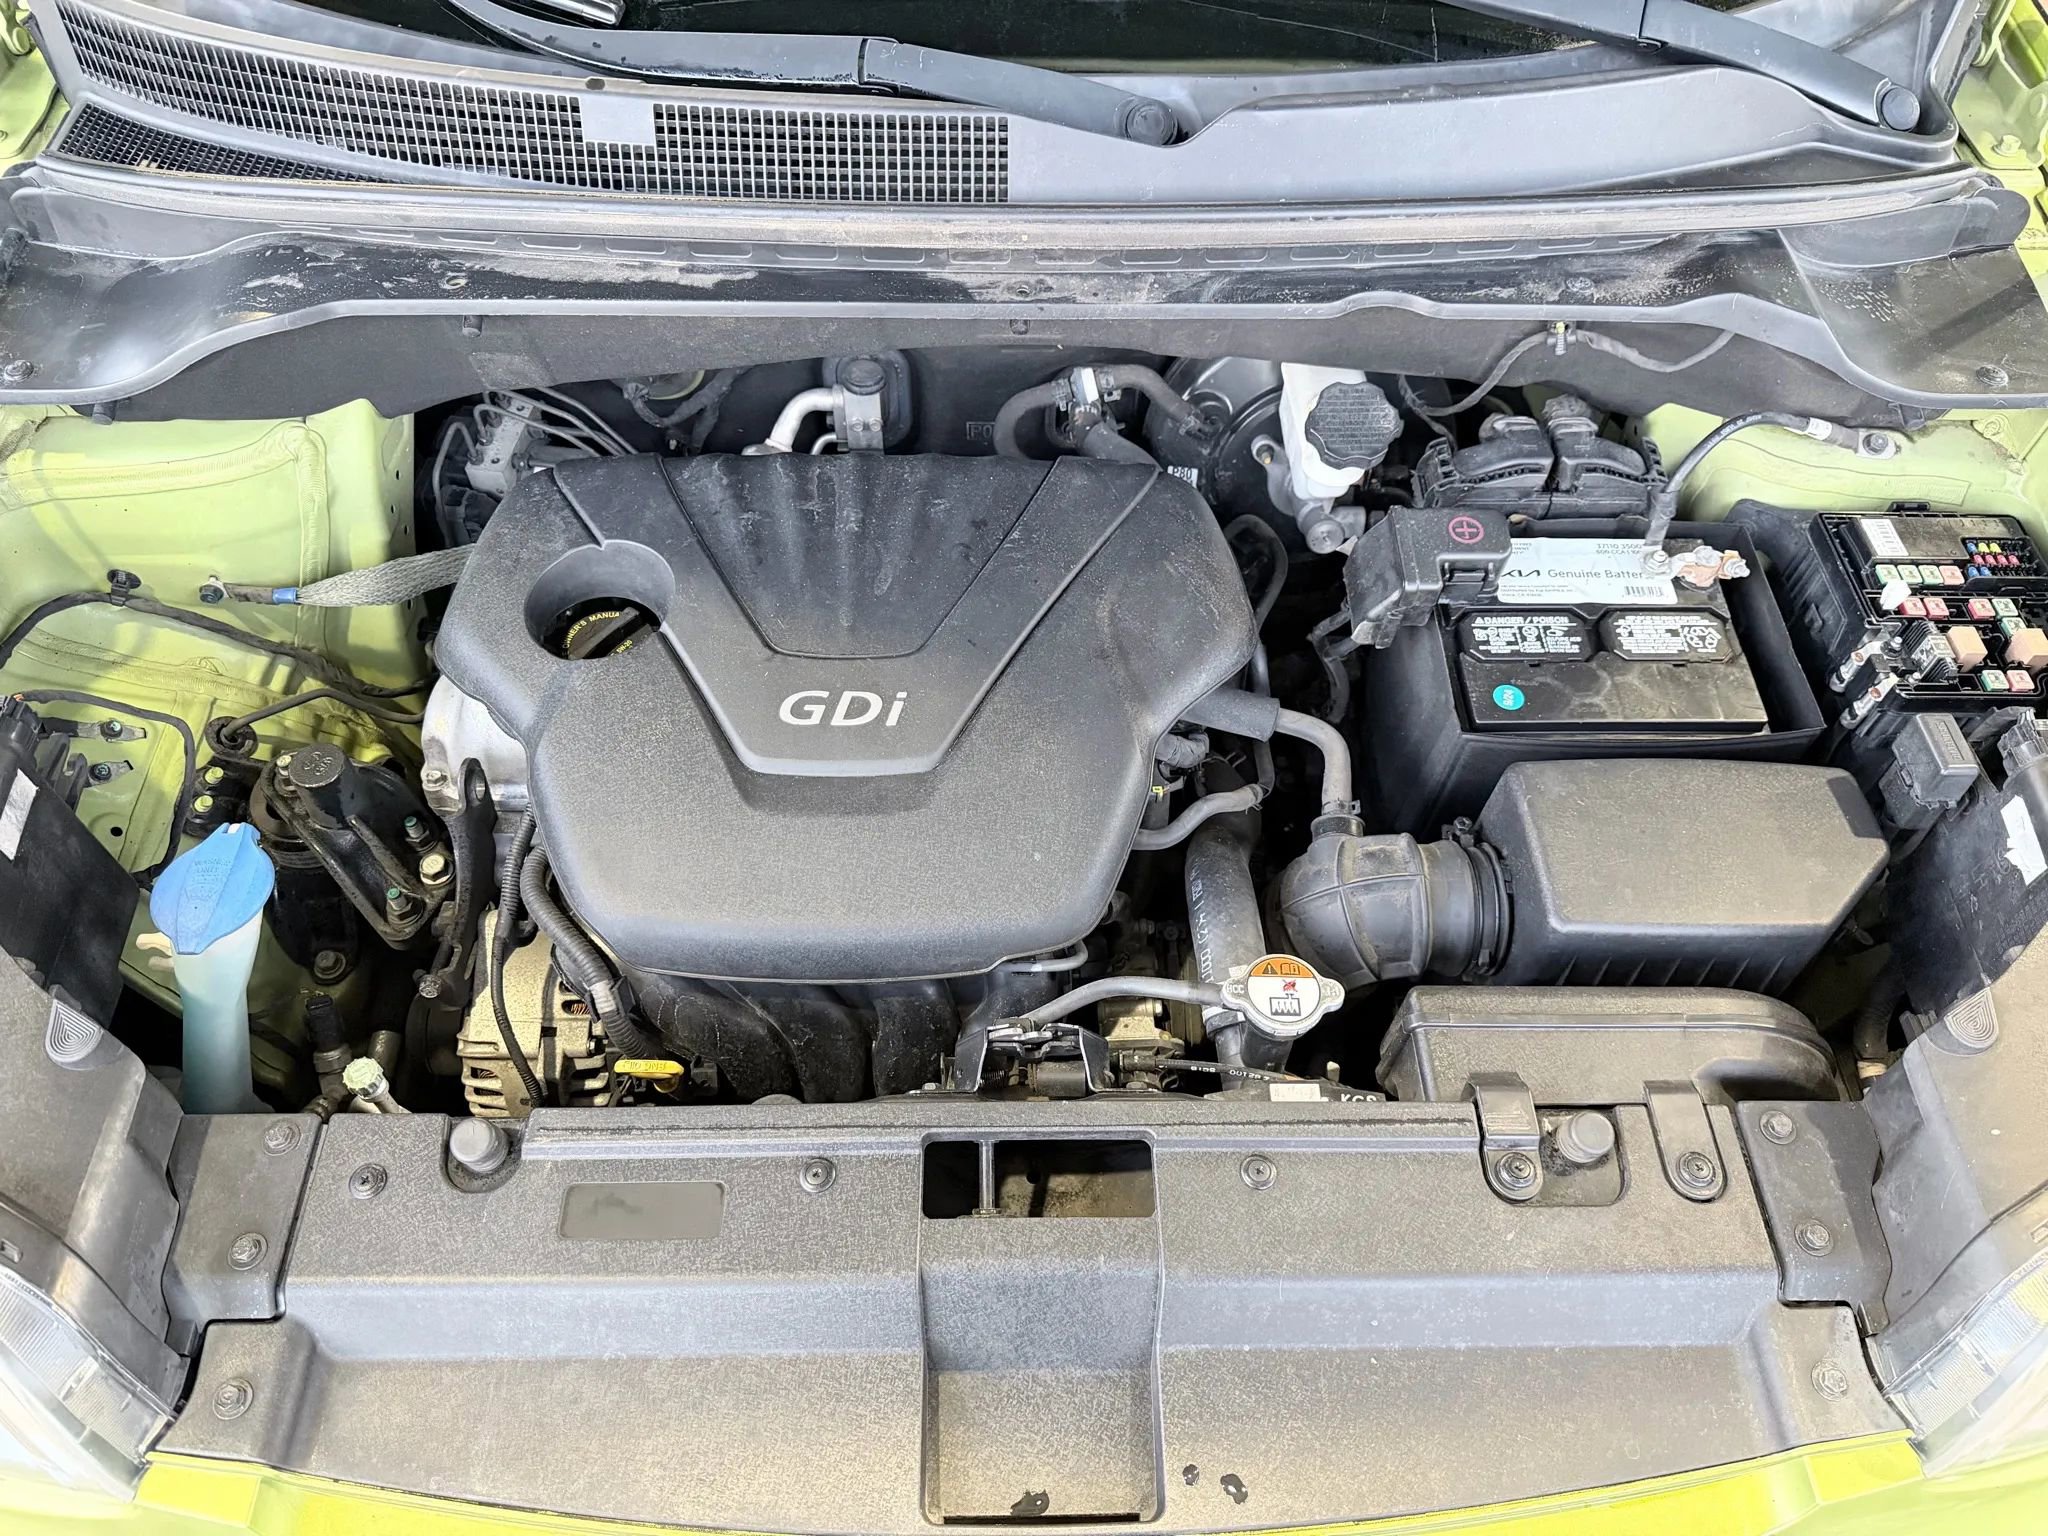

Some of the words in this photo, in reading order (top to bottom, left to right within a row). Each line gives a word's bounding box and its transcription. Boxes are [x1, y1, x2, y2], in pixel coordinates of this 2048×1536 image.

[1547, 568, 1601, 578] Genuine
[1604, 568, 1652, 579] Batter
[779, 691, 907, 726] GDi
